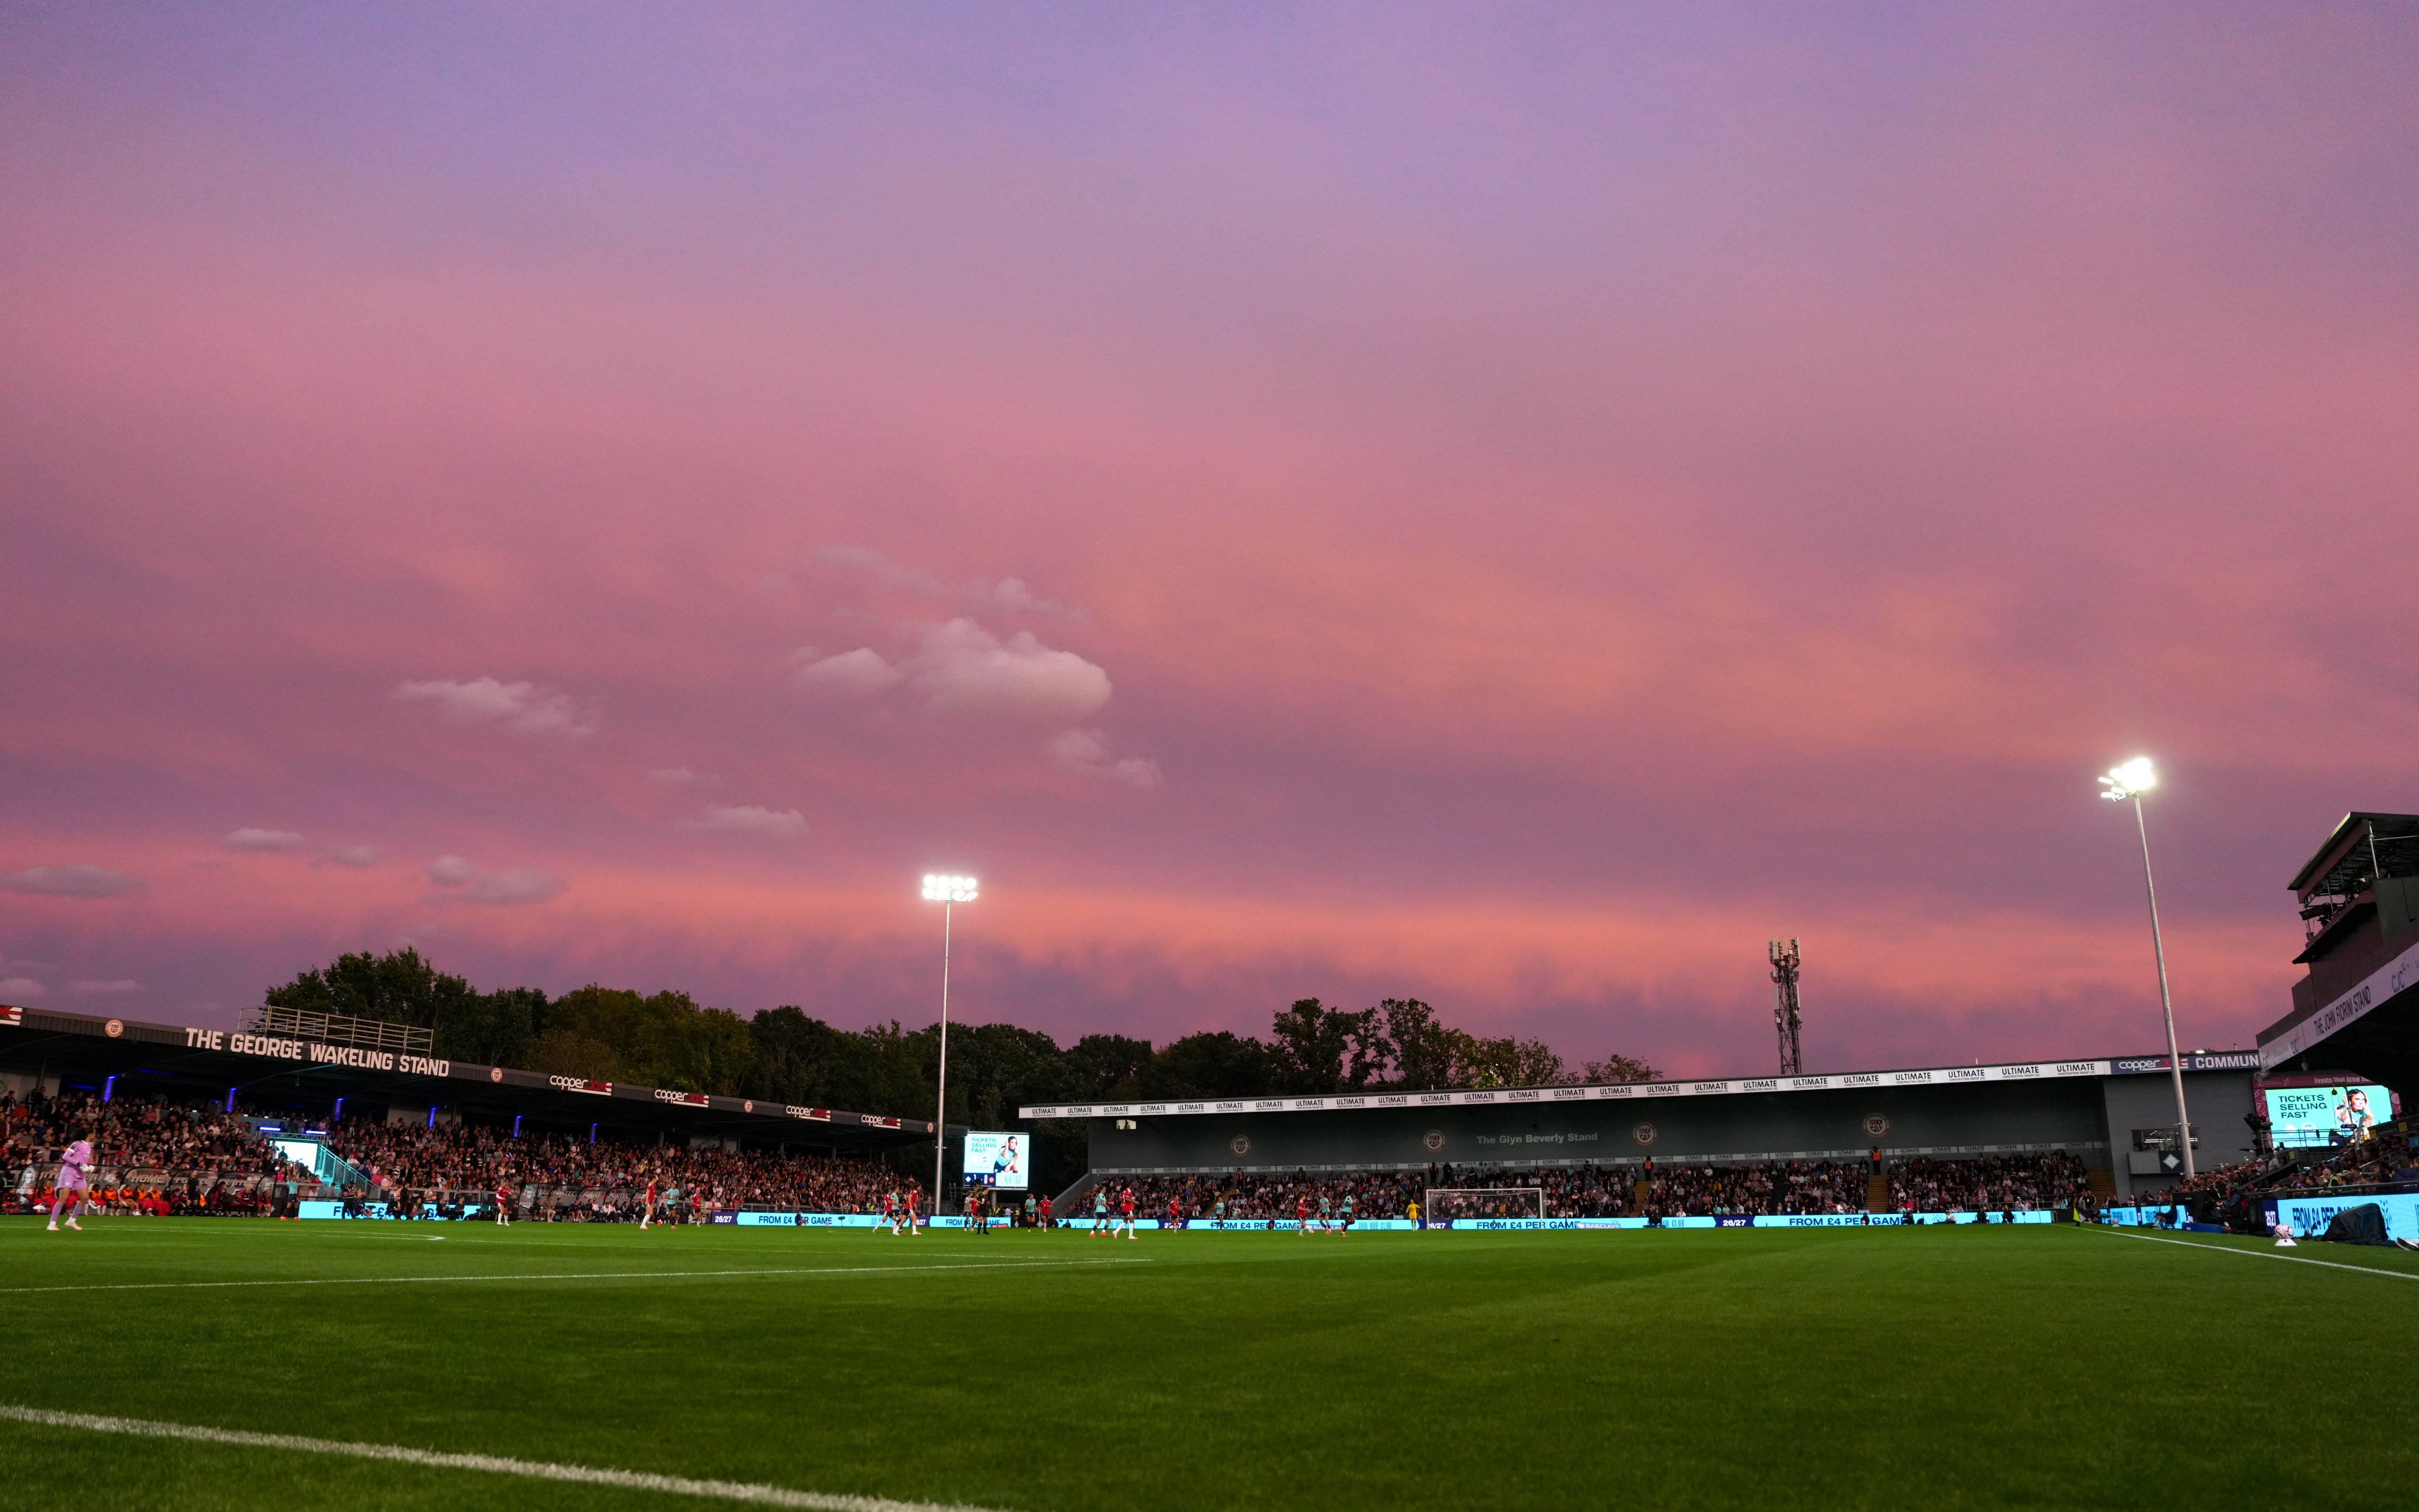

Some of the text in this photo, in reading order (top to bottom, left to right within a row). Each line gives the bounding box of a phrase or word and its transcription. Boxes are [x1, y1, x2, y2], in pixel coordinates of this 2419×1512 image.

[2314, 986, 2371, 1037] THE JOHN FIORINI STAND
[186, 1028, 449, 1077] THE GEORGE WAKELING STAND
[2001, 1066, 2039, 1075] ULTIMATE
[2056, 1063, 2095, 1072] ULTIMATE
[1844, 1075, 1879, 1083] ULTIMATE
[1896, 1072, 1931, 1080] ULTIMATE
[1793, 1077, 1827, 1086] ULTIMATE
[1499, 1135, 1522, 1145] Glyn
[1525, 1134, 1564, 1144] Beverly
[1567, 1132, 1598, 1142] Stand
[131, 1174, 164, 1183] HOME
[984, 1174, 987, 1184] 0
[1989, 1214, 1999, 1223] OUR
[2265, 1211, 2277, 1226] 26/27
[2292, 1207, 2312, 1229] FROM
[2312, 1207, 2321, 1230] £4
